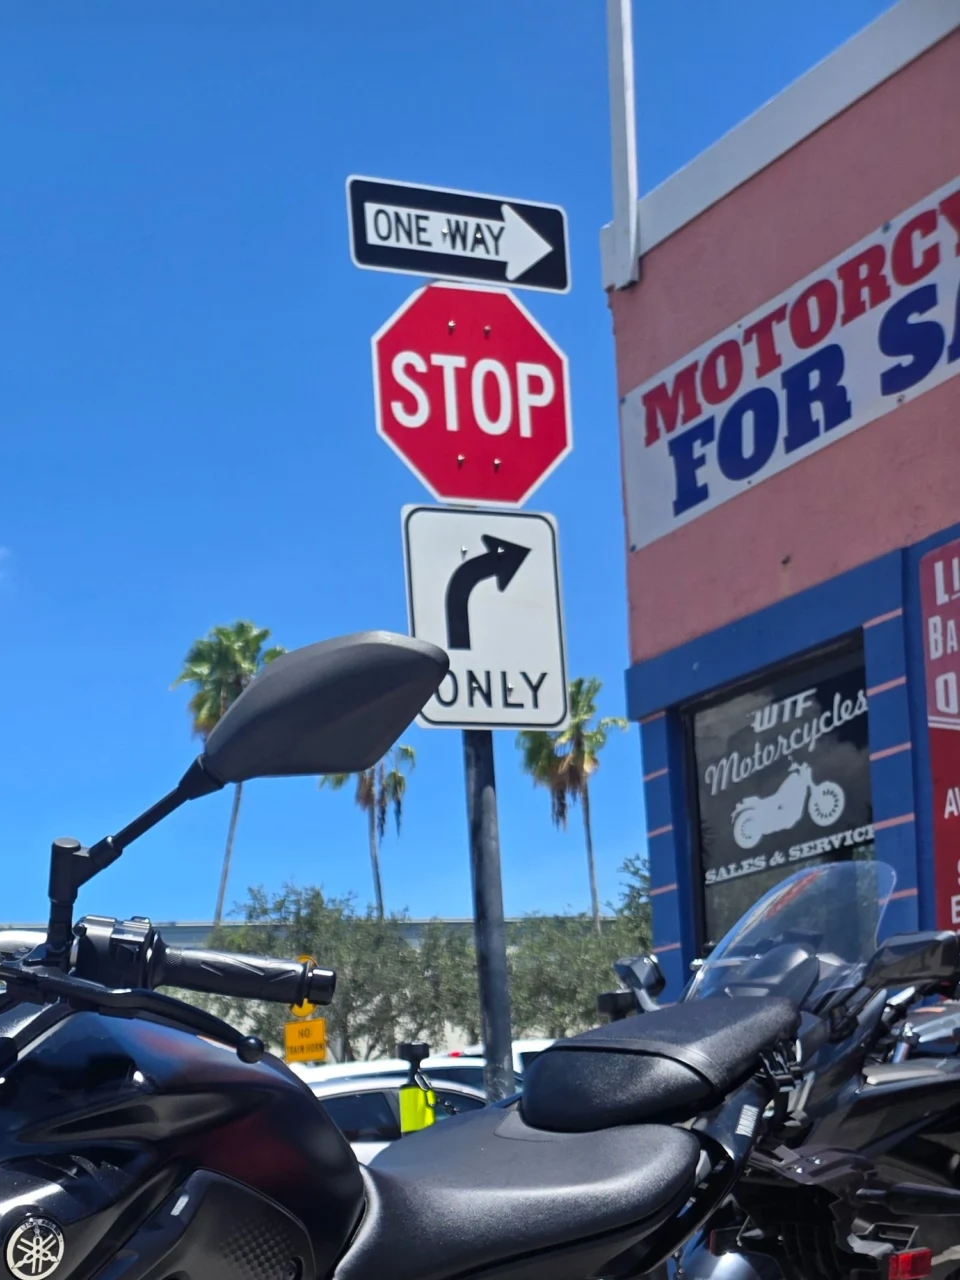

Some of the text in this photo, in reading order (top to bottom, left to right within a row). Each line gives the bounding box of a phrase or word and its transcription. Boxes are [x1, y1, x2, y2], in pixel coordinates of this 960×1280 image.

[373, 208, 505, 256] ONE WAY
[391, 350, 555, 438] STOP
[668, 277, 960, 517] FOR S
[435, 669, 548, 709] ONLY
[751, 688, 817, 733] WTF
[705, 689, 869, 796] Motorcycles
[705, 854, 766, 885] SALES
[769, 850, 785, 867] &
[297, 1028, 311, 1039] NO
